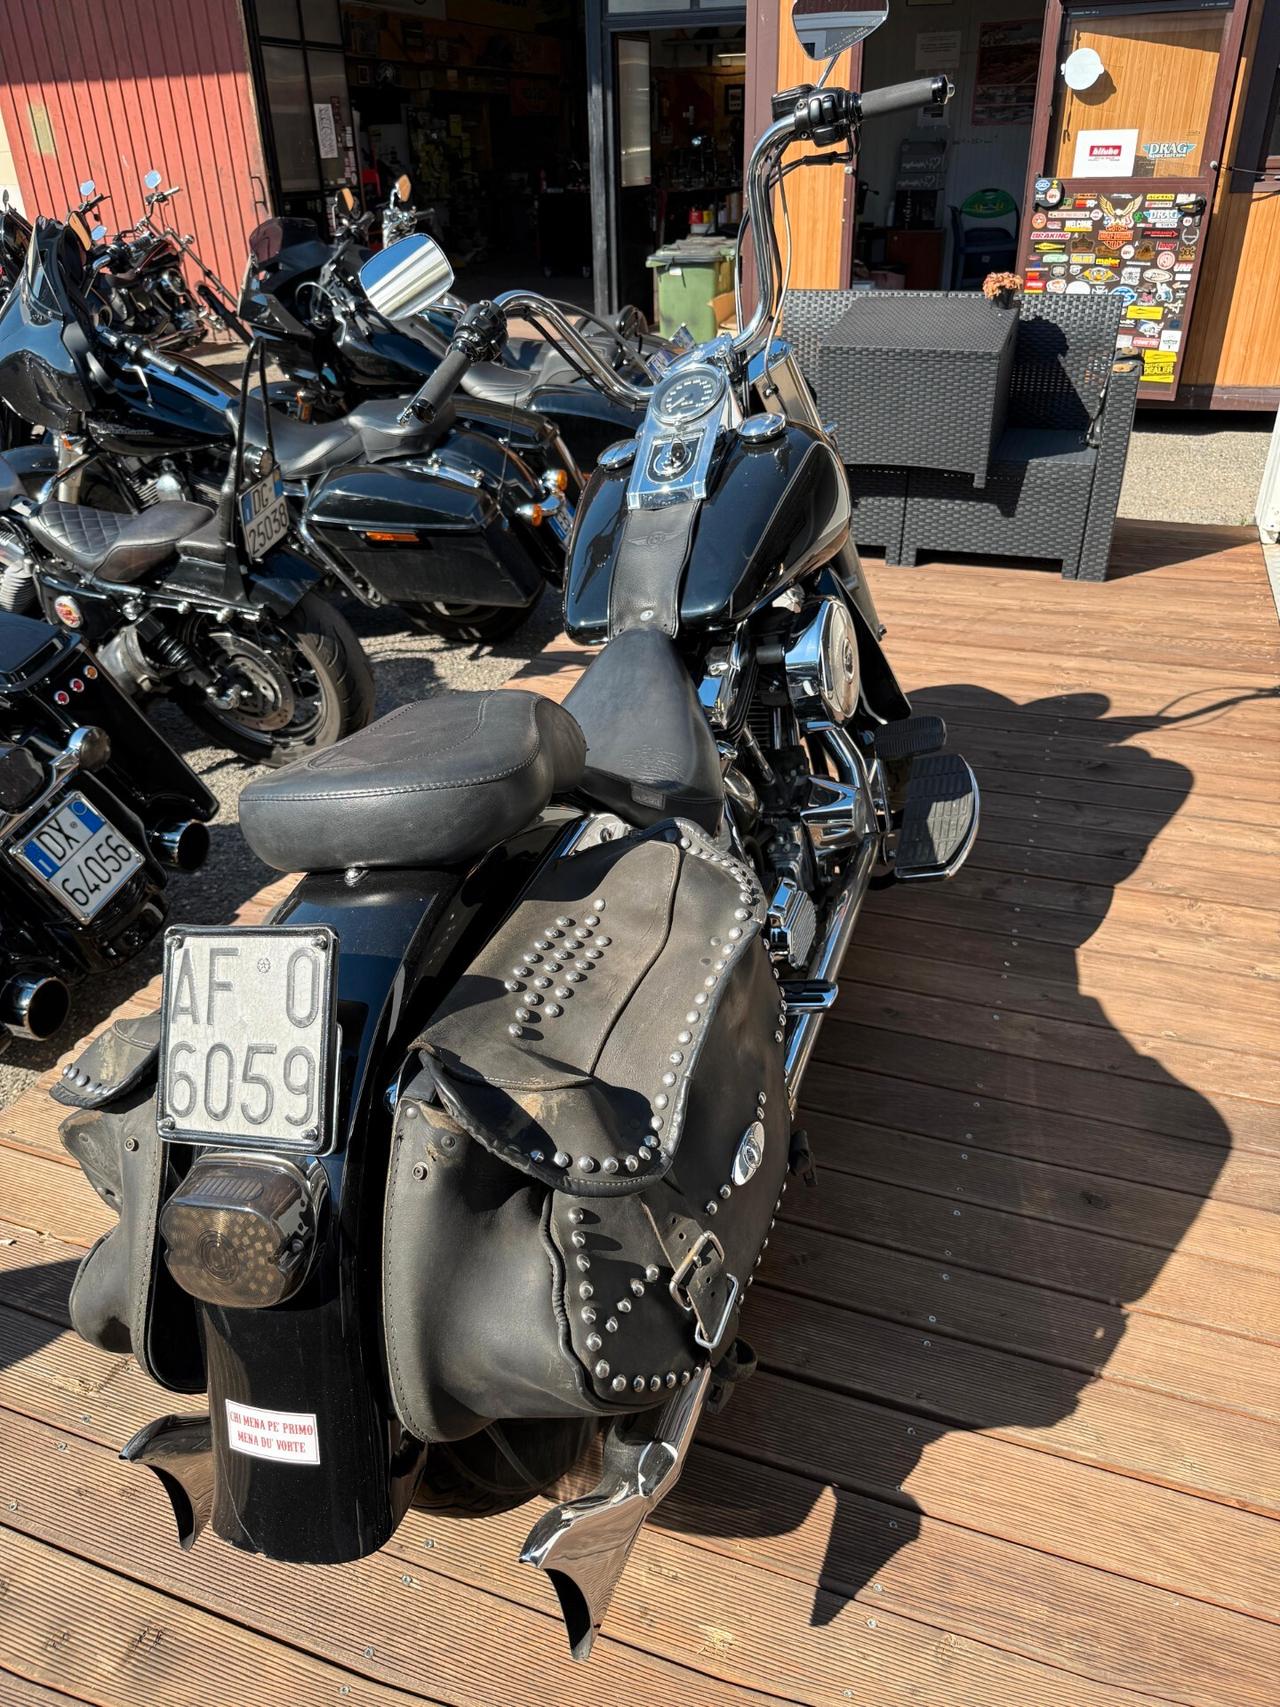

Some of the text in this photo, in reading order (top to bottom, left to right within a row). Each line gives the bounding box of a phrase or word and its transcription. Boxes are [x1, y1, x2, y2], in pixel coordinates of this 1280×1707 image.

[1148, 142, 1188, 155] DRAG
[1150, 209, 1179, 219] DRAG
[249, 503, 287, 554] 25038
[37, 818, 81, 861] DX
[61, 834, 132, 906] 64056
[171, 946, 320, 1029] AF 0
[168, 1041, 316, 1126] 6059
[229, 1411, 241, 1425] CHI
[243, 1415, 266, 1430] MENA
[282, 1422, 314, 1436] PRIMO
[237, 1430, 259, 1447] MENA
[276, 1439, 306, 1453] VORTE
